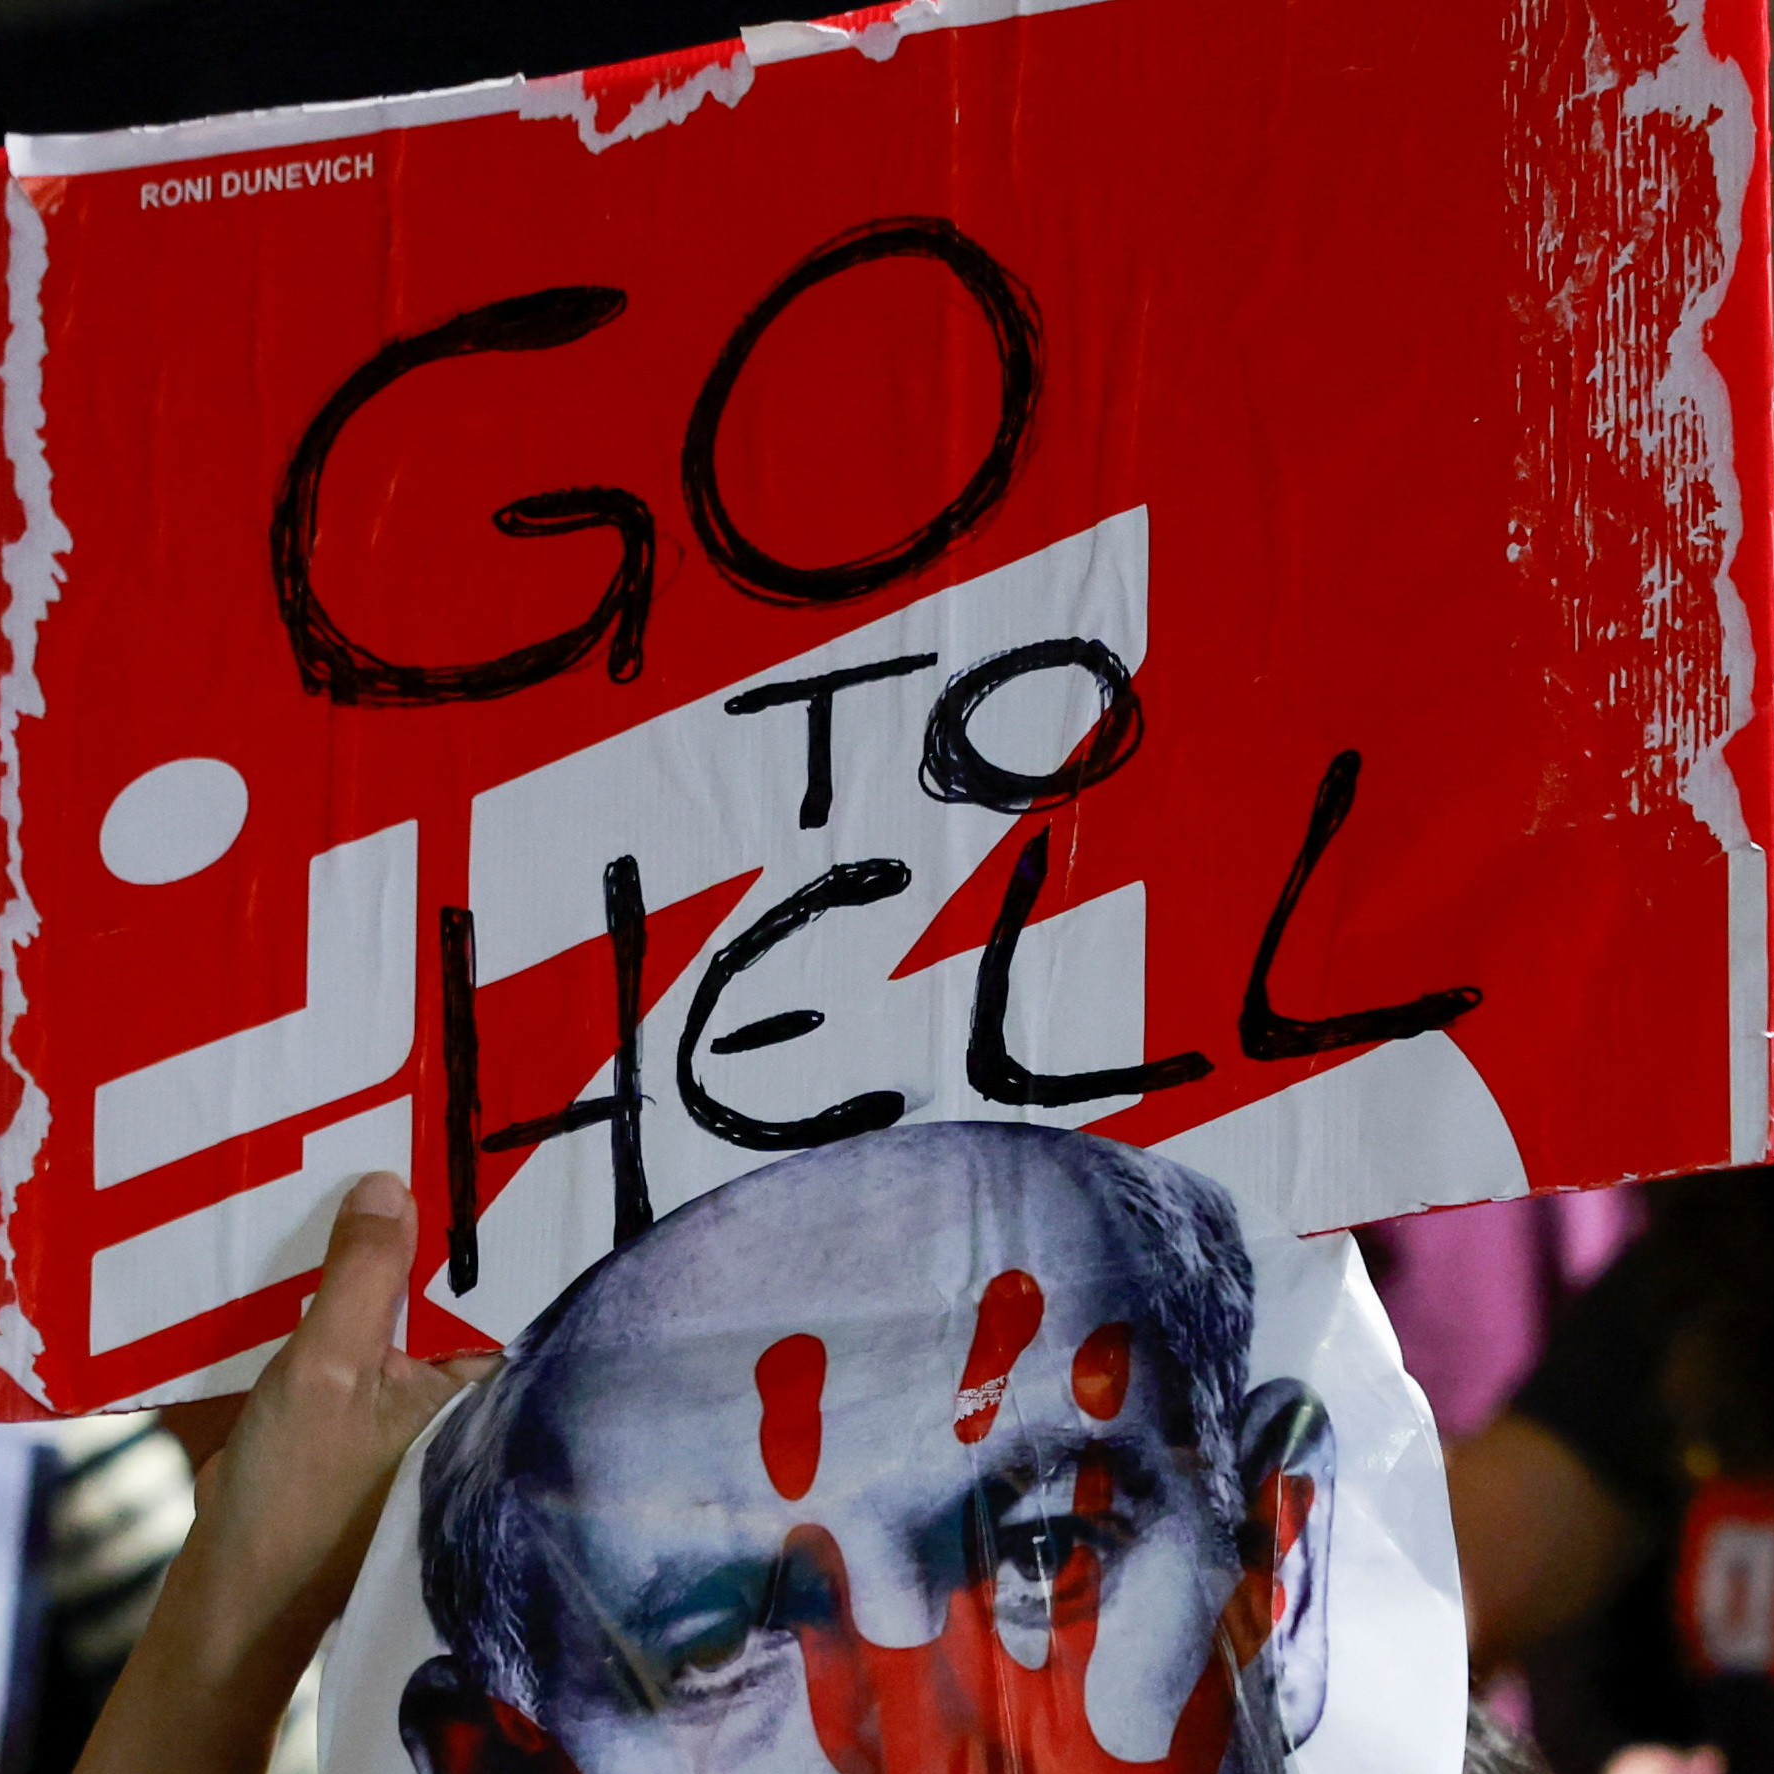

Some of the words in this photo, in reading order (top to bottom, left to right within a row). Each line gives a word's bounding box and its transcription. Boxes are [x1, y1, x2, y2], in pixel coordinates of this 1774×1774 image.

[139, 174, 212, 211] RONI
[221, 151, 375, 199] DUNEVICH
[267, 214, 1045, 708] GO
[724, 636, 1145, 830] TO
[439, 750, 1484, 1296] HELL
